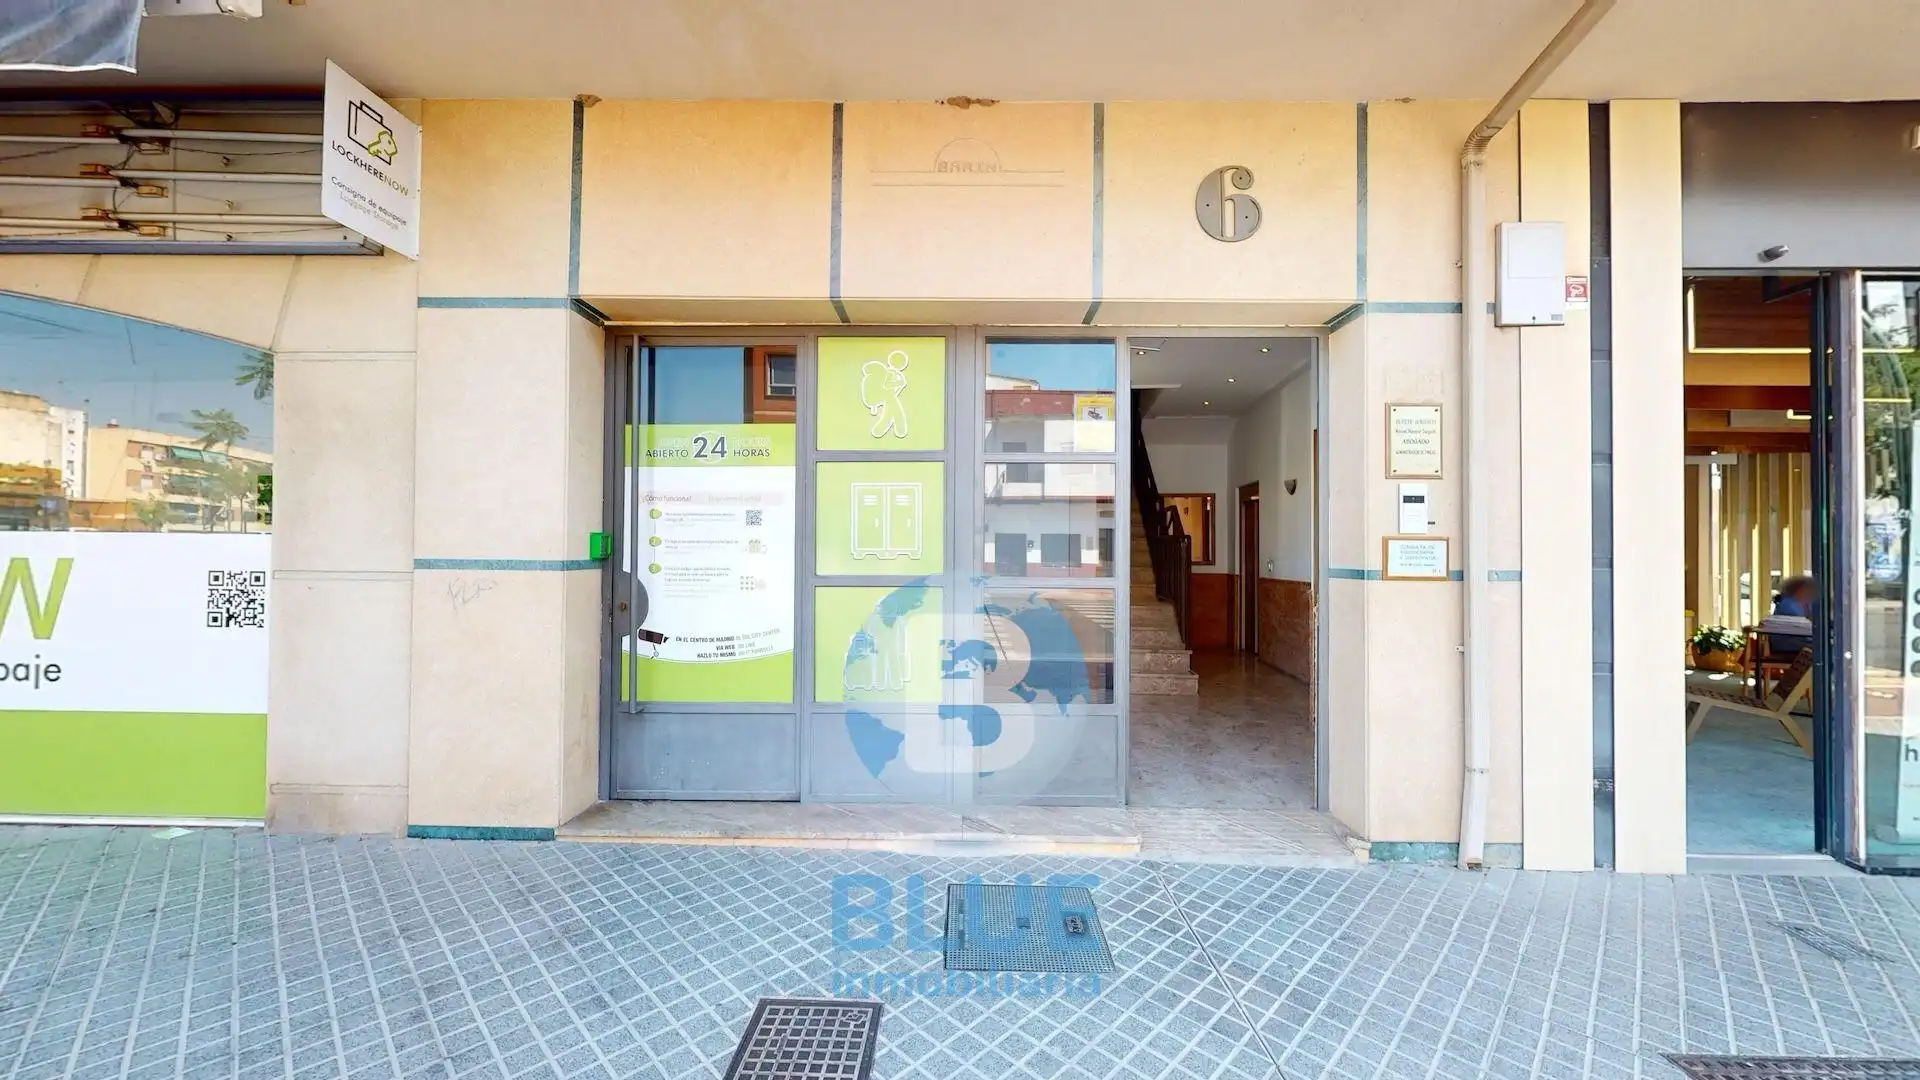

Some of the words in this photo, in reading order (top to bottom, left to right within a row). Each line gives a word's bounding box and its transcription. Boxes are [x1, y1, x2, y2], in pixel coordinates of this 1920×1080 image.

[331, 140, 409, 196] LOCKHERENOW
[331, 176, 367, 203] Consigna
[368, 198, 377, 209] de
[1195, 165, 1262, 243] 6
[645, 448, 689, 458] ABIERTO
[693, 436, 728, 459] 24
[733, 448, 770, 457] HORAS
